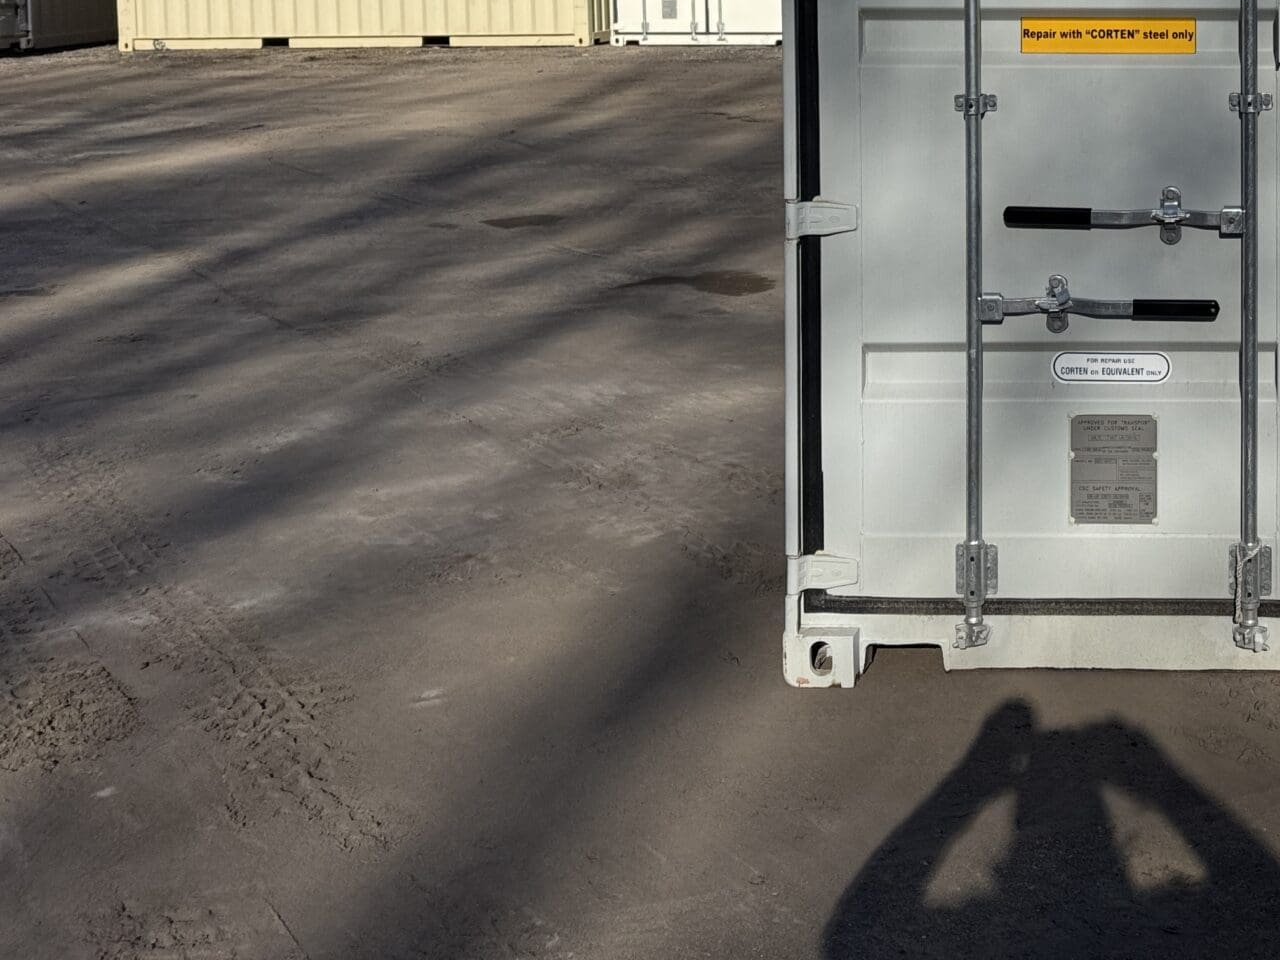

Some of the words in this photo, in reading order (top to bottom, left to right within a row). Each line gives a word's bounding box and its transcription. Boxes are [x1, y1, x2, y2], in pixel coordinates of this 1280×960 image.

[1023, 29, 1056, 40] Repair
[1060, 29, 1082, 39] with
[1143, 30, 1168, 39] steel
[1172, 30, 1193, 41] only
[1060, 367, 1088, 375] CORTEN
[1102, 368, 1144, 376] EQUIVALENT
